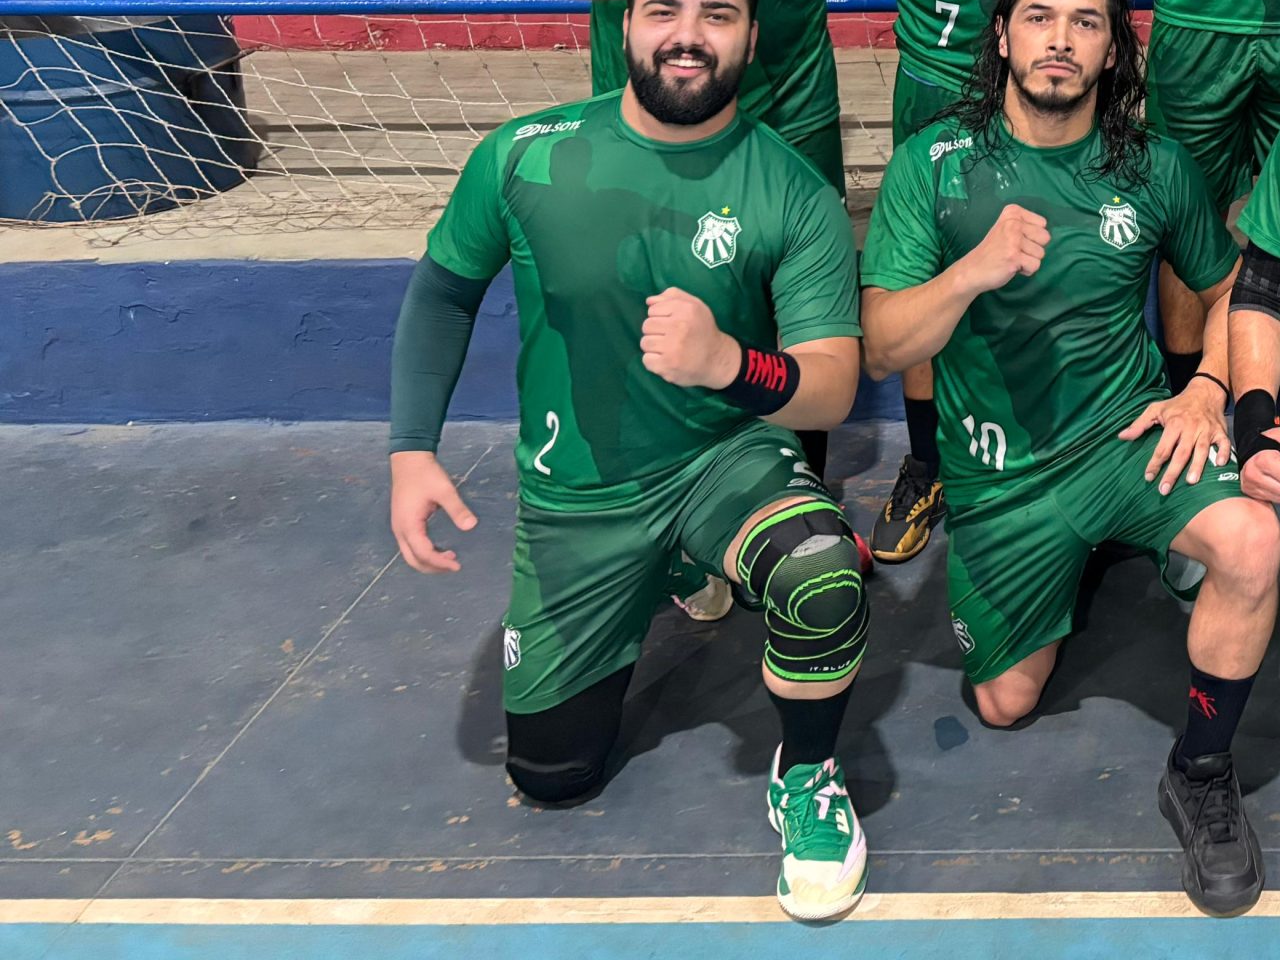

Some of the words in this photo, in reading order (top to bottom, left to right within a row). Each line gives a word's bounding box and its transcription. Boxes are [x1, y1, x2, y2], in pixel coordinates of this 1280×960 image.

[935, 0, 960, 47] 7
[512, 120, 583, 142] Duson
[929, 136, 973, 161] Duson
[745, 349, 787, 391] FMH
[533, 410, 560, 476] 2
[961, 414, 1007, 472] 10
